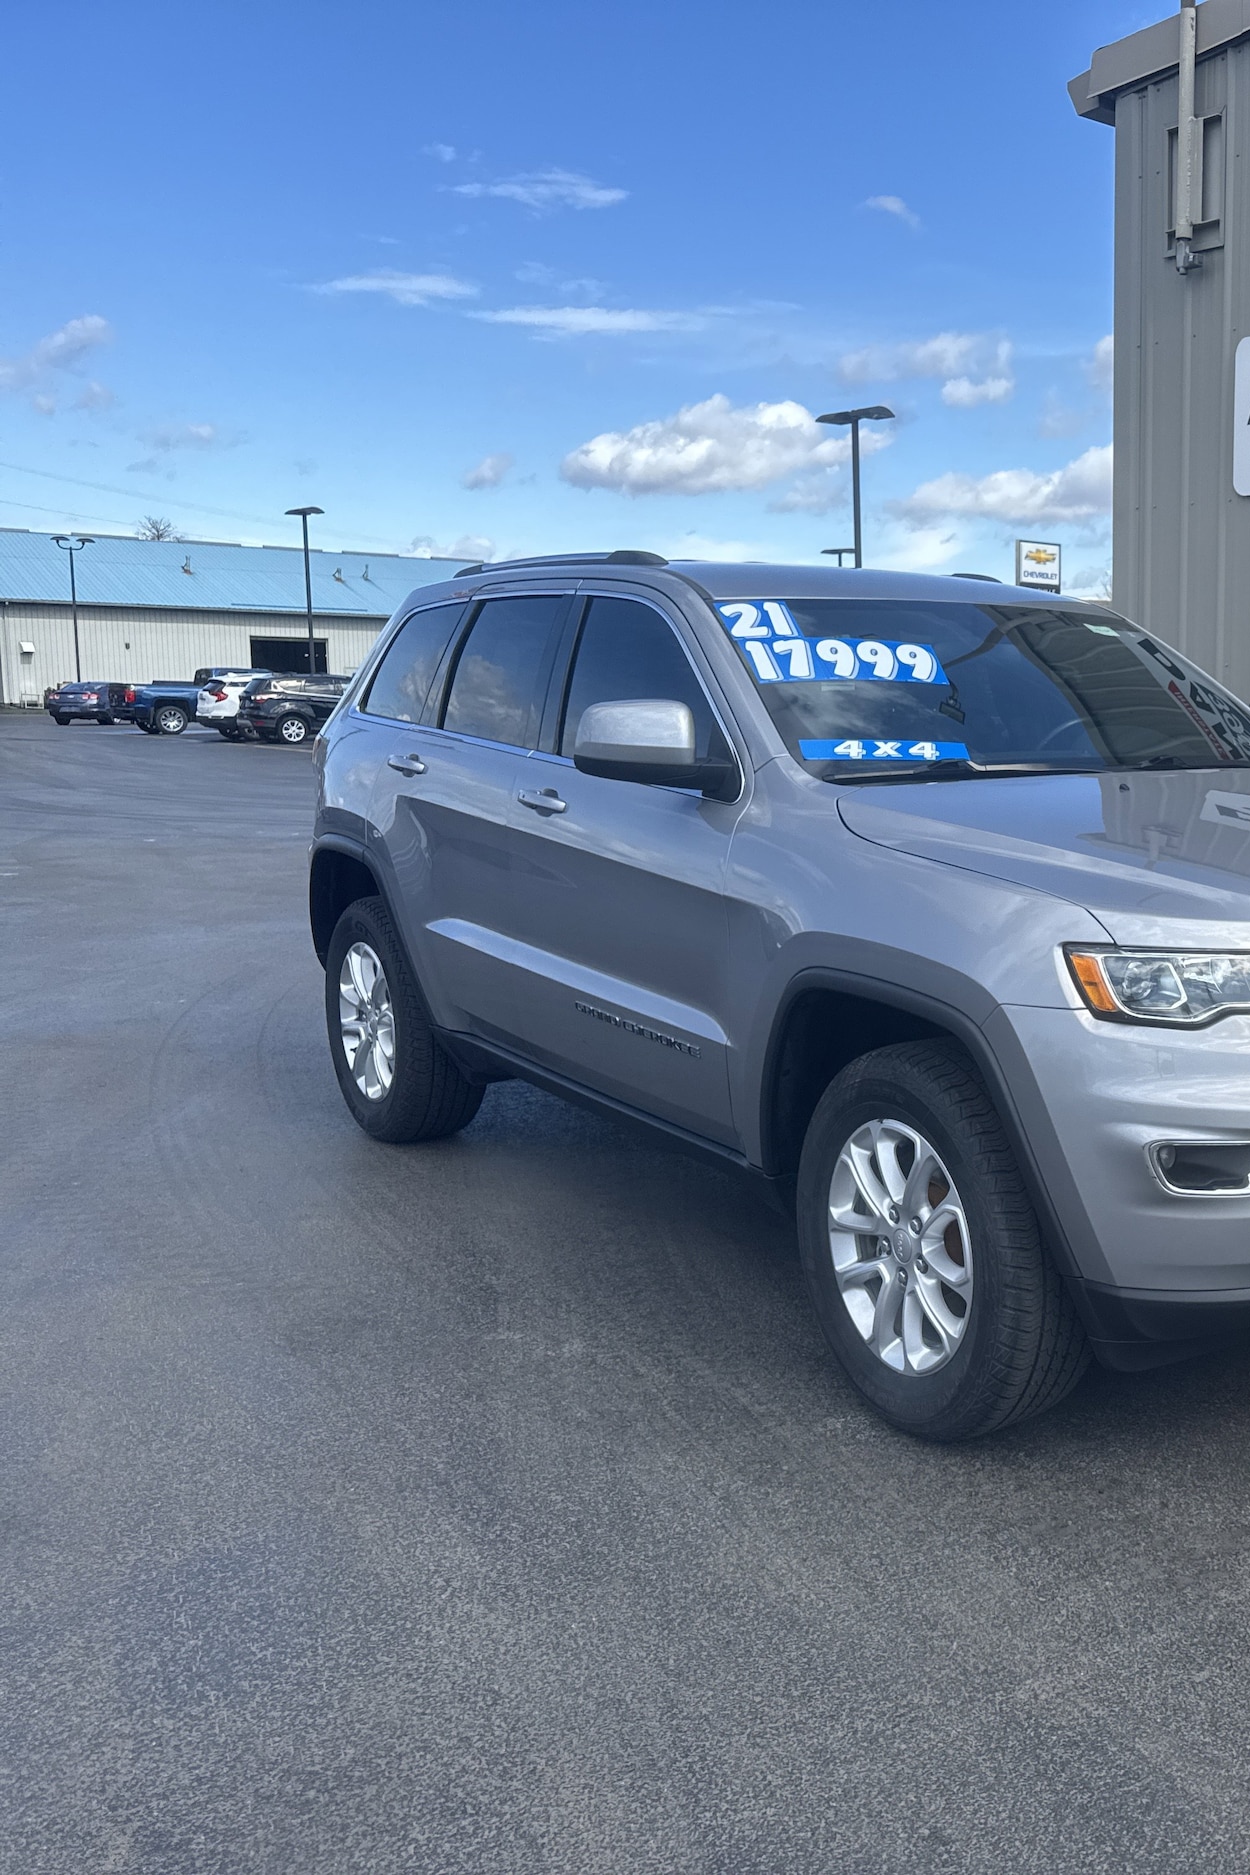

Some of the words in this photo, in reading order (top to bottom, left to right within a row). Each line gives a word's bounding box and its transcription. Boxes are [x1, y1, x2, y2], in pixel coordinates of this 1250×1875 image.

[1023, 570, 1058, 580] CHEVROLET
[719, 601, 799, 638] 21
[745, 639, 937, 681] 17999
[575, 1001, 621, 1027] GRAND
[623, 1020, 701, 1058] CHEROKEE
